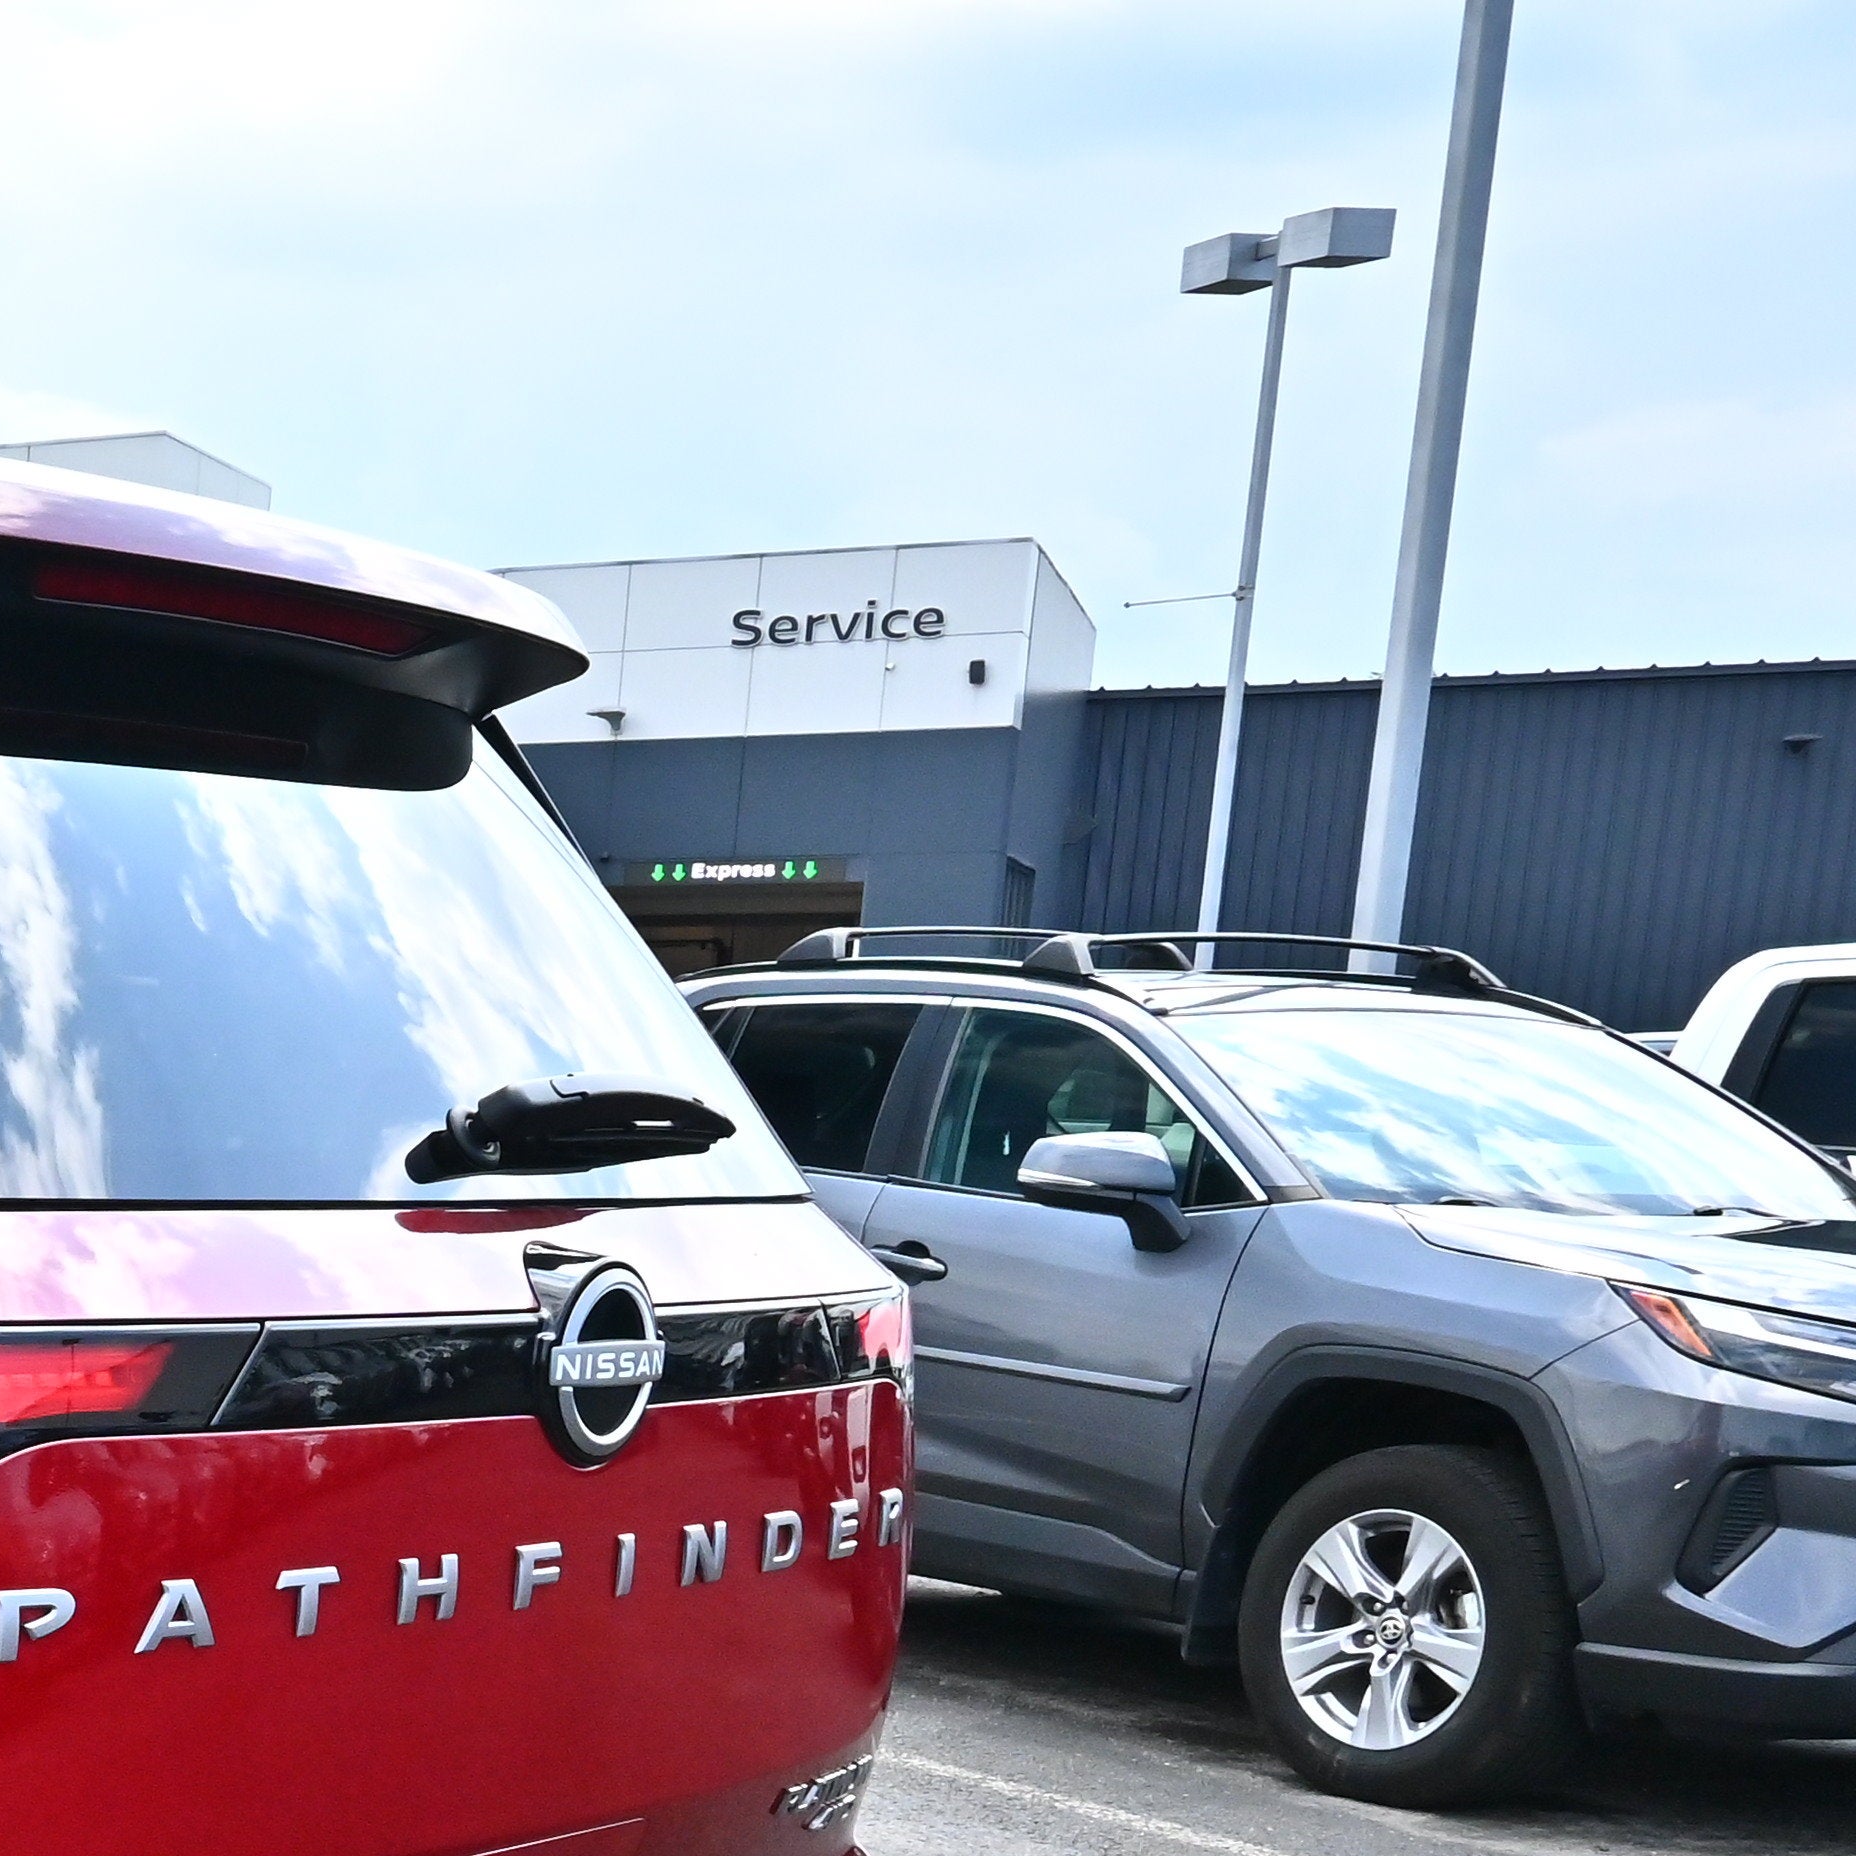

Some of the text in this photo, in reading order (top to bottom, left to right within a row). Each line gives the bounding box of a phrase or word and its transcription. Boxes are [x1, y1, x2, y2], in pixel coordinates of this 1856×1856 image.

[730, 599, 946, 648] Service
[690, 861, 777, 882] Express
[555, 1349, 664, 1381] NISSAN
